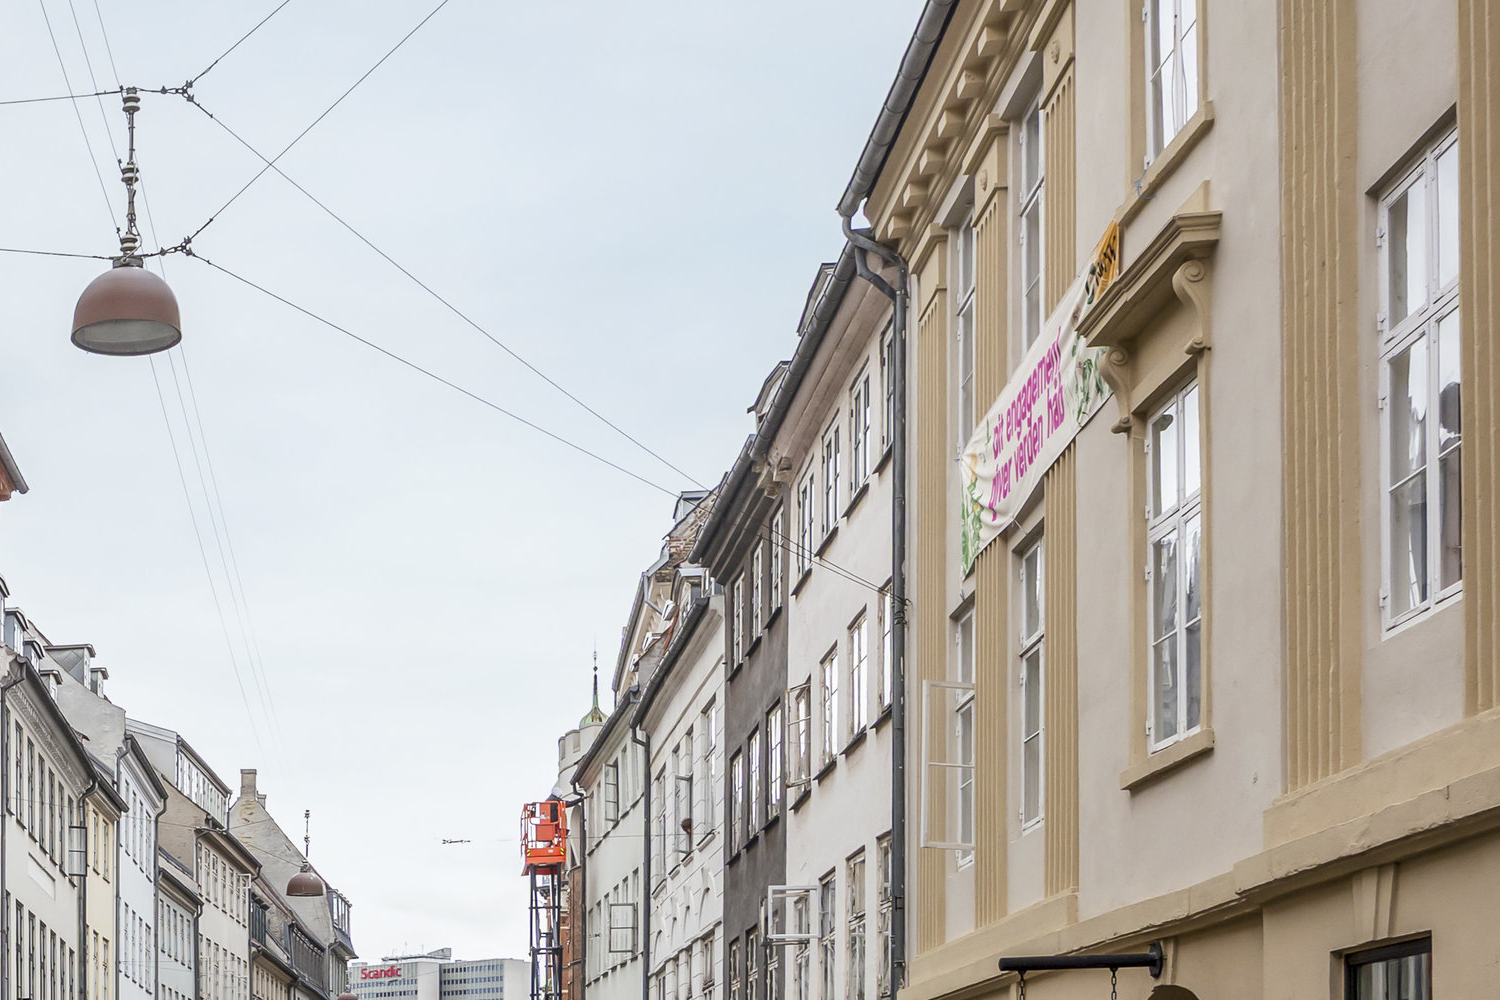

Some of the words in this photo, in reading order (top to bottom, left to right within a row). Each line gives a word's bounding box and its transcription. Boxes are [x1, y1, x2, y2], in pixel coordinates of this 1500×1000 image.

[1006, 325, 1062, 443] engagement
[1014, 413, 1044, 483] verden
[1047, 371, 1065, 439] håb
[360, 965, 402, 980] Scandic
